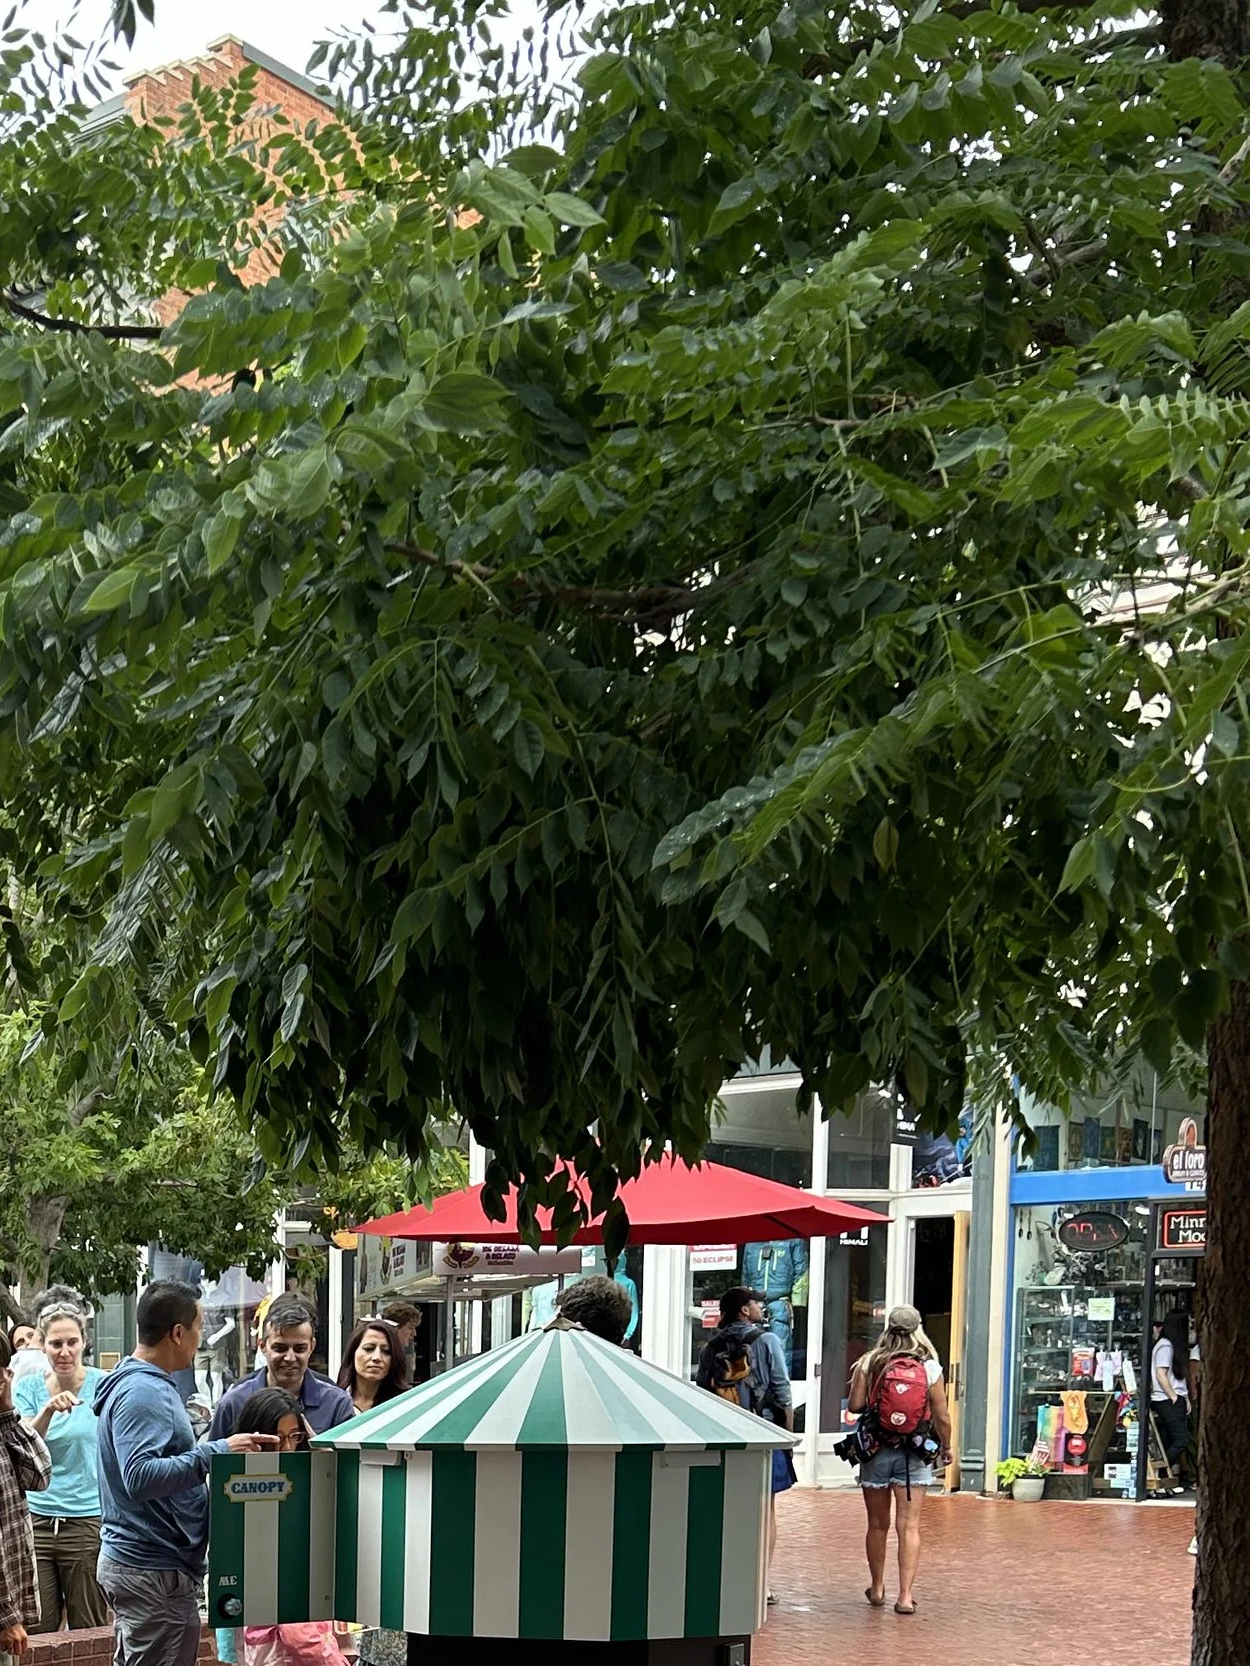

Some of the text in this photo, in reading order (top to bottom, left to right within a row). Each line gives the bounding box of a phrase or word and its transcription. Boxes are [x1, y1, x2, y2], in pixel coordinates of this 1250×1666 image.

[1173, 1150, 1205, 1170] el loro
[703, 1255, 734, 1263] ECLIPSE
[231, 1481, 285, 1494] CANOPY
[219, 1575, 237, 1586] ME
